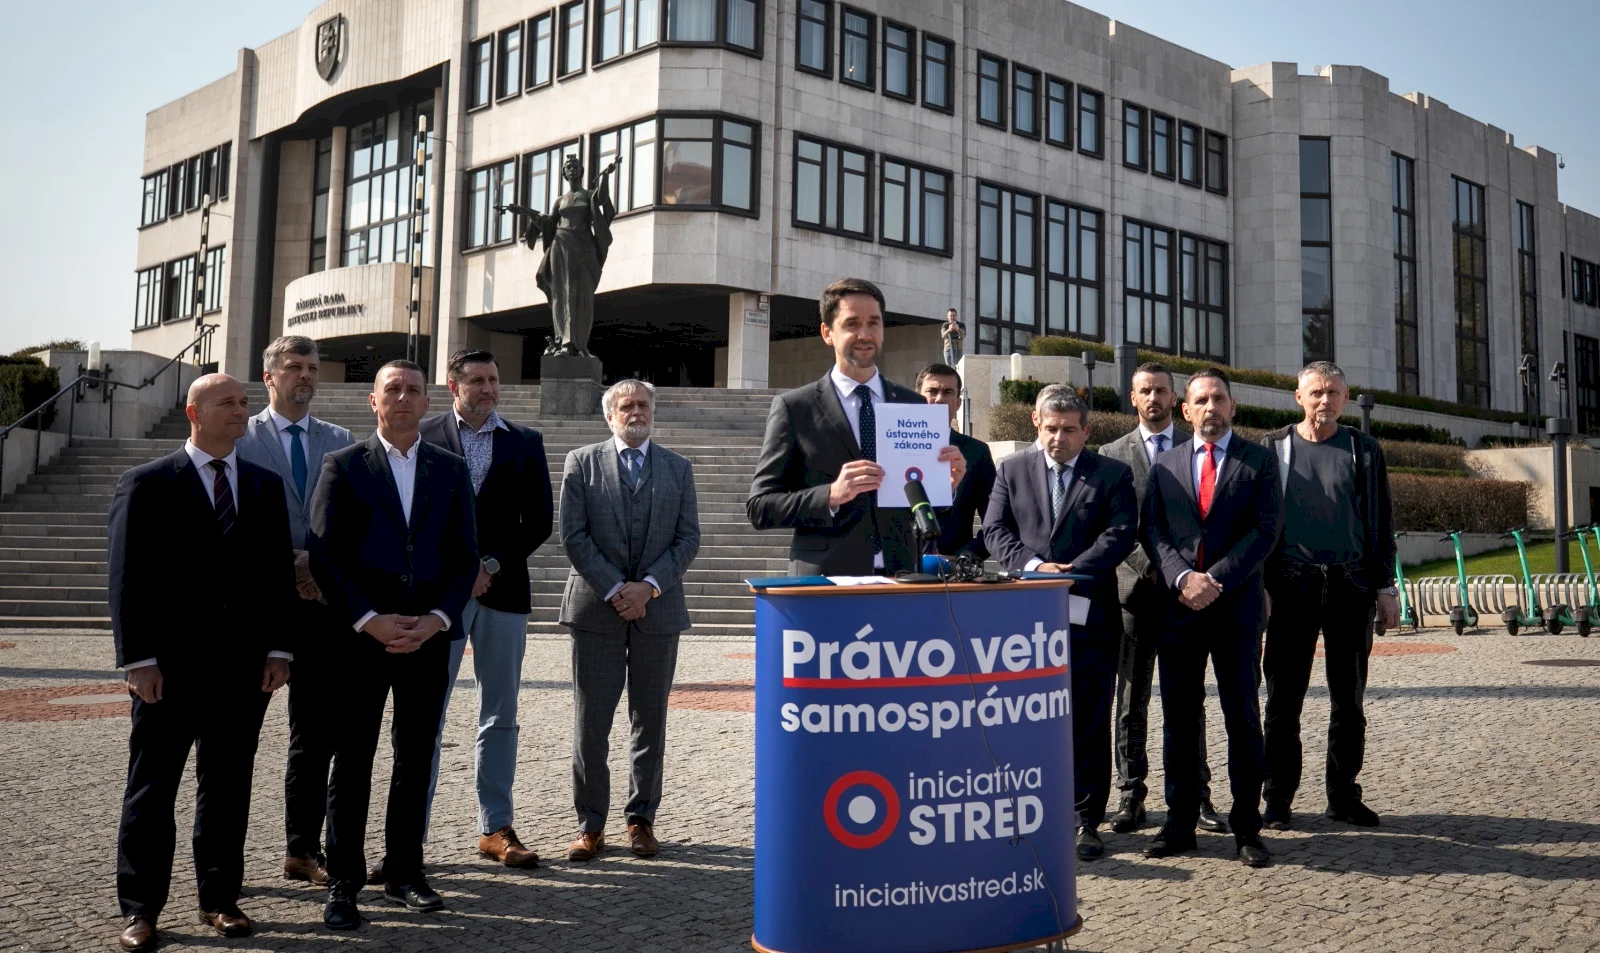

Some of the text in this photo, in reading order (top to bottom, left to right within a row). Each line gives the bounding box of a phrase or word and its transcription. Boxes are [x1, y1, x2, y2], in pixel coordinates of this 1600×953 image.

[324, 293, 346, 305] RADA
[886, 429, 940, 439] ústavného
[897, 419, 928, 429] Návrh
[894, 440, 932, 450] zákona
[783, 621, 1068, 680] Právo veta
[781, 684, 1070, 738] samosprávam
[909, 762, 1042, 800] iniciatíva
[909, 795, 1044, 846] STRED
[835, 868, 1045, 907] iniciativastred.sk
